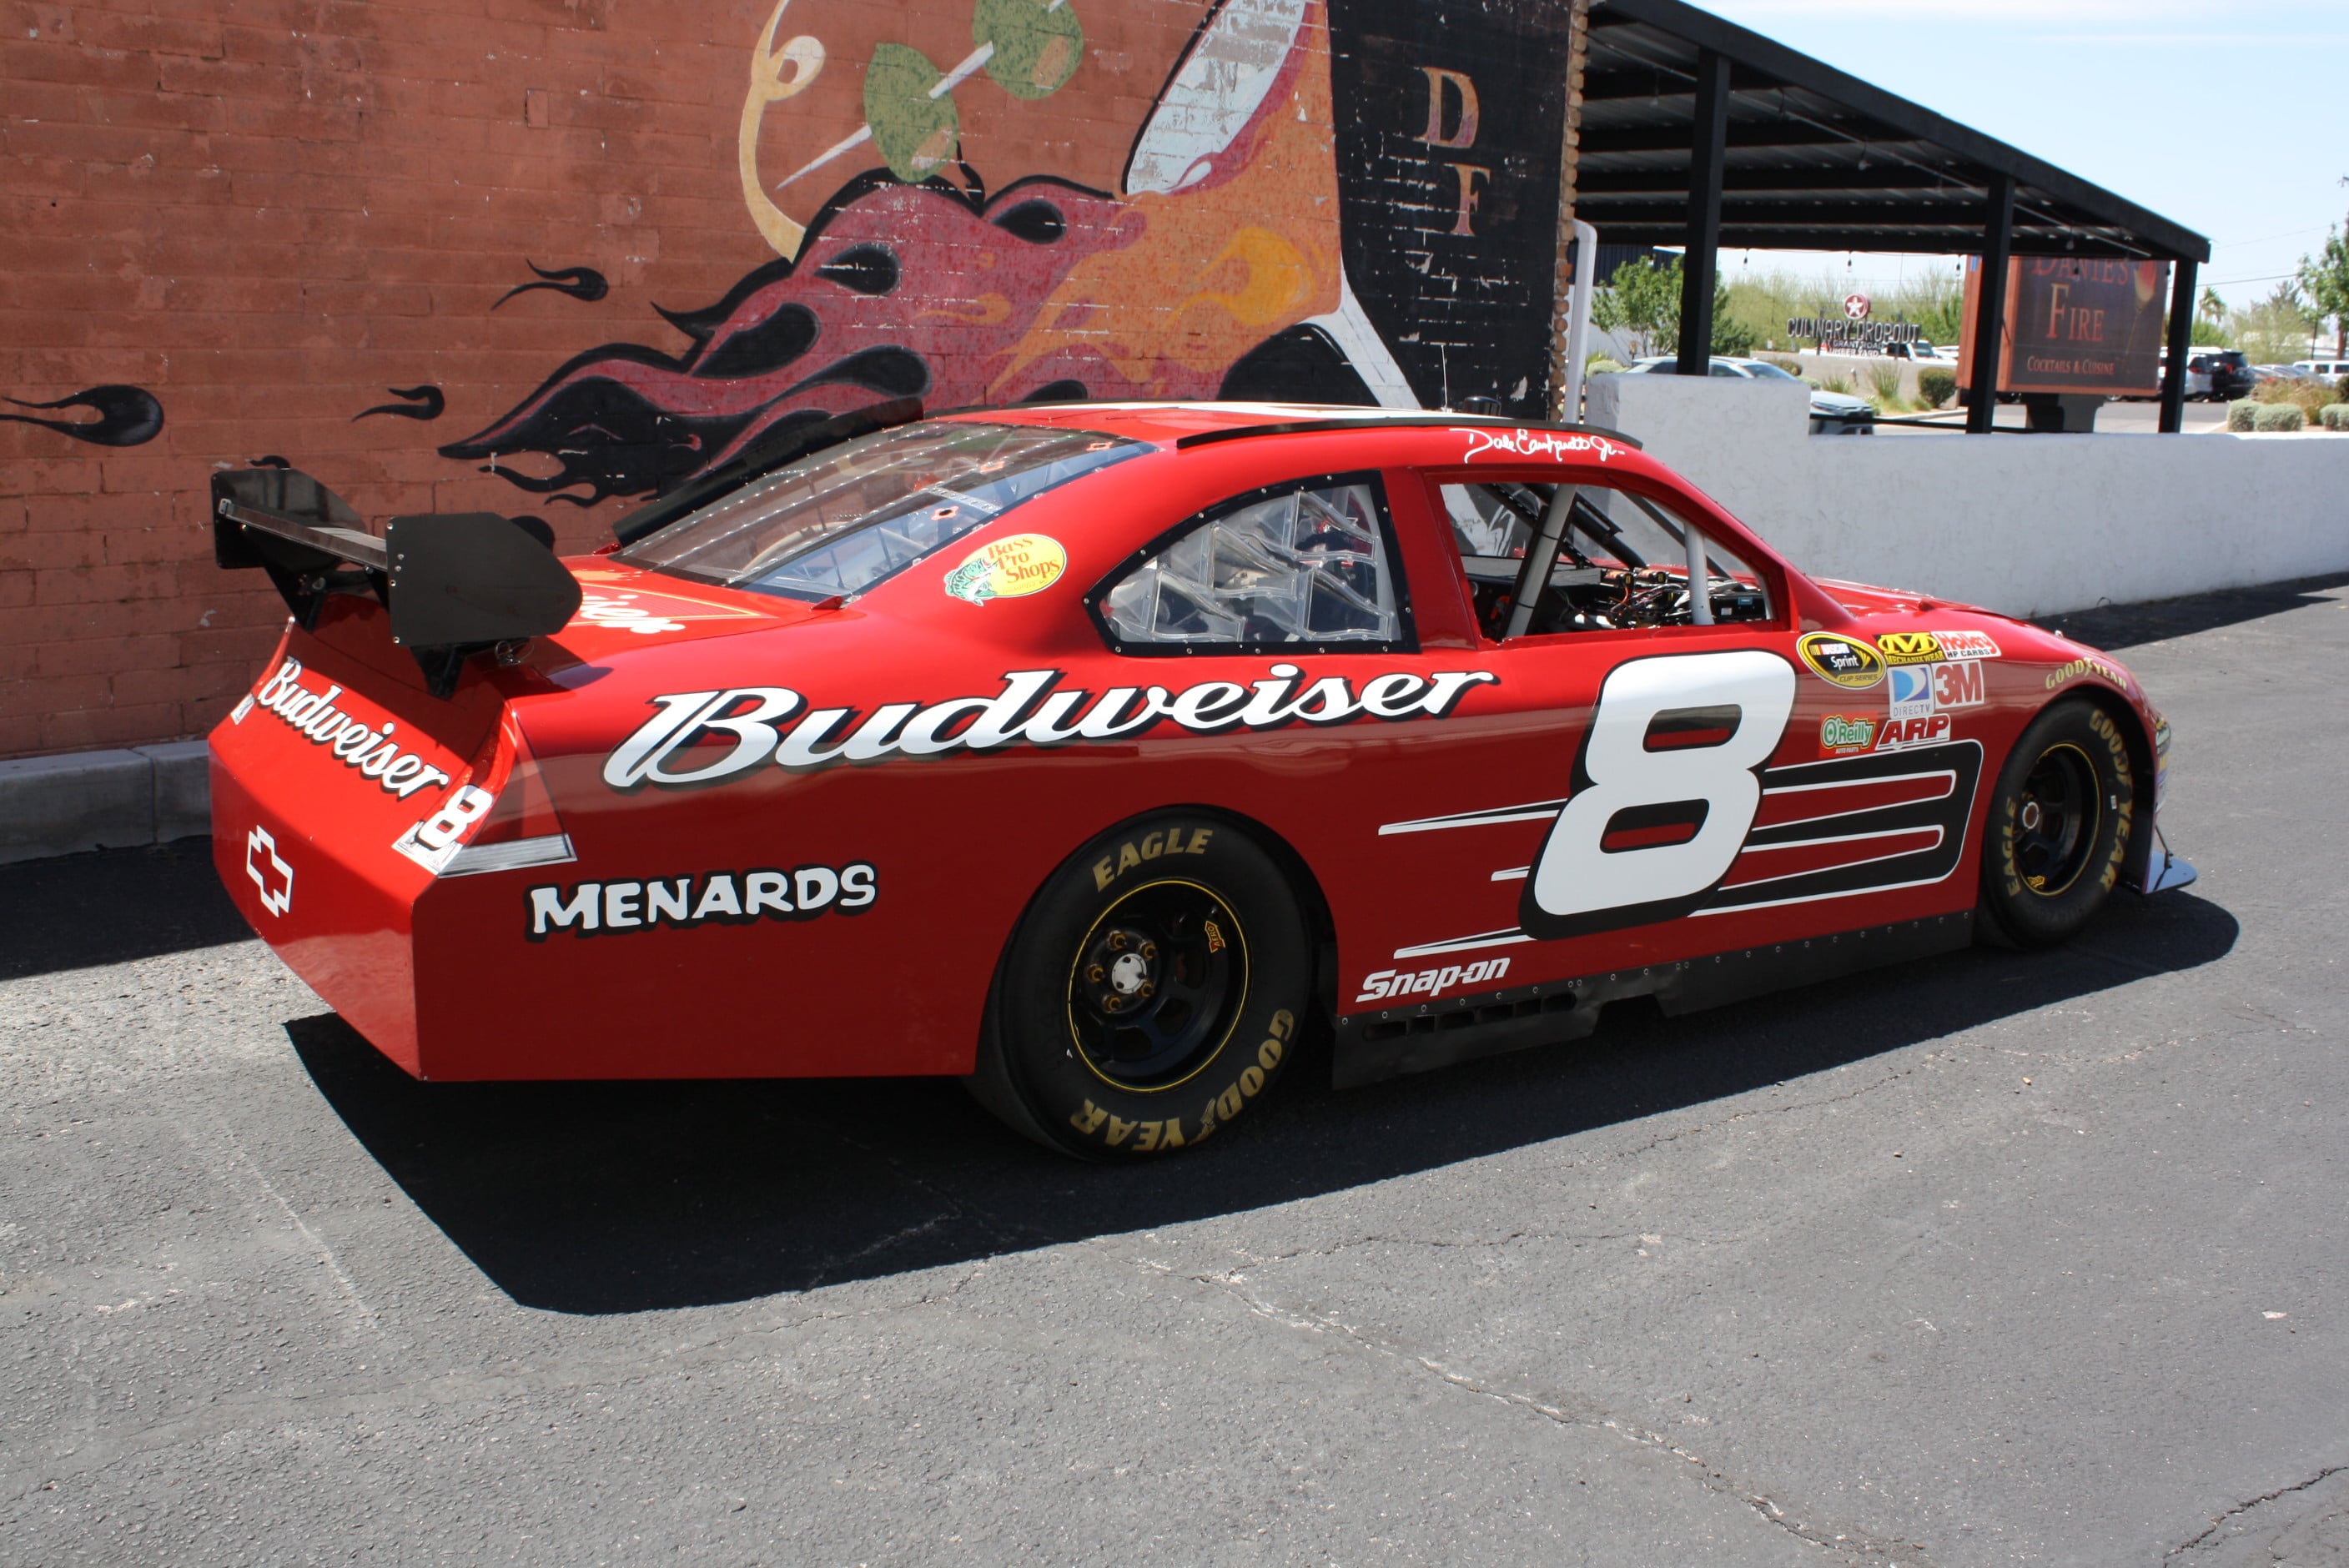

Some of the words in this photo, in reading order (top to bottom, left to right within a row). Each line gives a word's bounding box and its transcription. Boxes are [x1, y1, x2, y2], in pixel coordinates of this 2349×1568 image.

[1413, 67, 1480, 148] D
[1443, 163, 1491, 237] F
[1787, 318, 1851, 341] CULINARY
[1856, 320, 1921, 344] DROPOUT
[2046, 283, 2105, 342] FIRE
[1833, 340, 1859, 349] GRANT
[988, 538, 1033, 560] Bass
[998, 552, 1029, 570] Pro
[1005, 559, 1060, 583] Shops
[1831, 655, 1859, 671] Sprint
[1947, 650, 1959, 658] HP
[1961, 648, 1990, 657] CARBS
[1839, 675, 1854, 683] CUP
[1854, 673, 1878, 681] SERIES
[1935, 662, 1983, 706] 3M
[258, 656, 450, 798] Budweiser
[601, 662, 1495, 788] Budweiser
[1823, 717, 1874, 744] O'Reilly
[1880, 715, 1949, 745] ARP
[1531, 650, 1797, 921] 8
[418, 784, 494, 849] 8
[1092, 827, 1213, 893] EAGLE
[2002, 797, 2022, 897] EAGLE
[529, 864, 877, 935] MENARDS
[1355, 957, 1511, 1003] Snap-on
